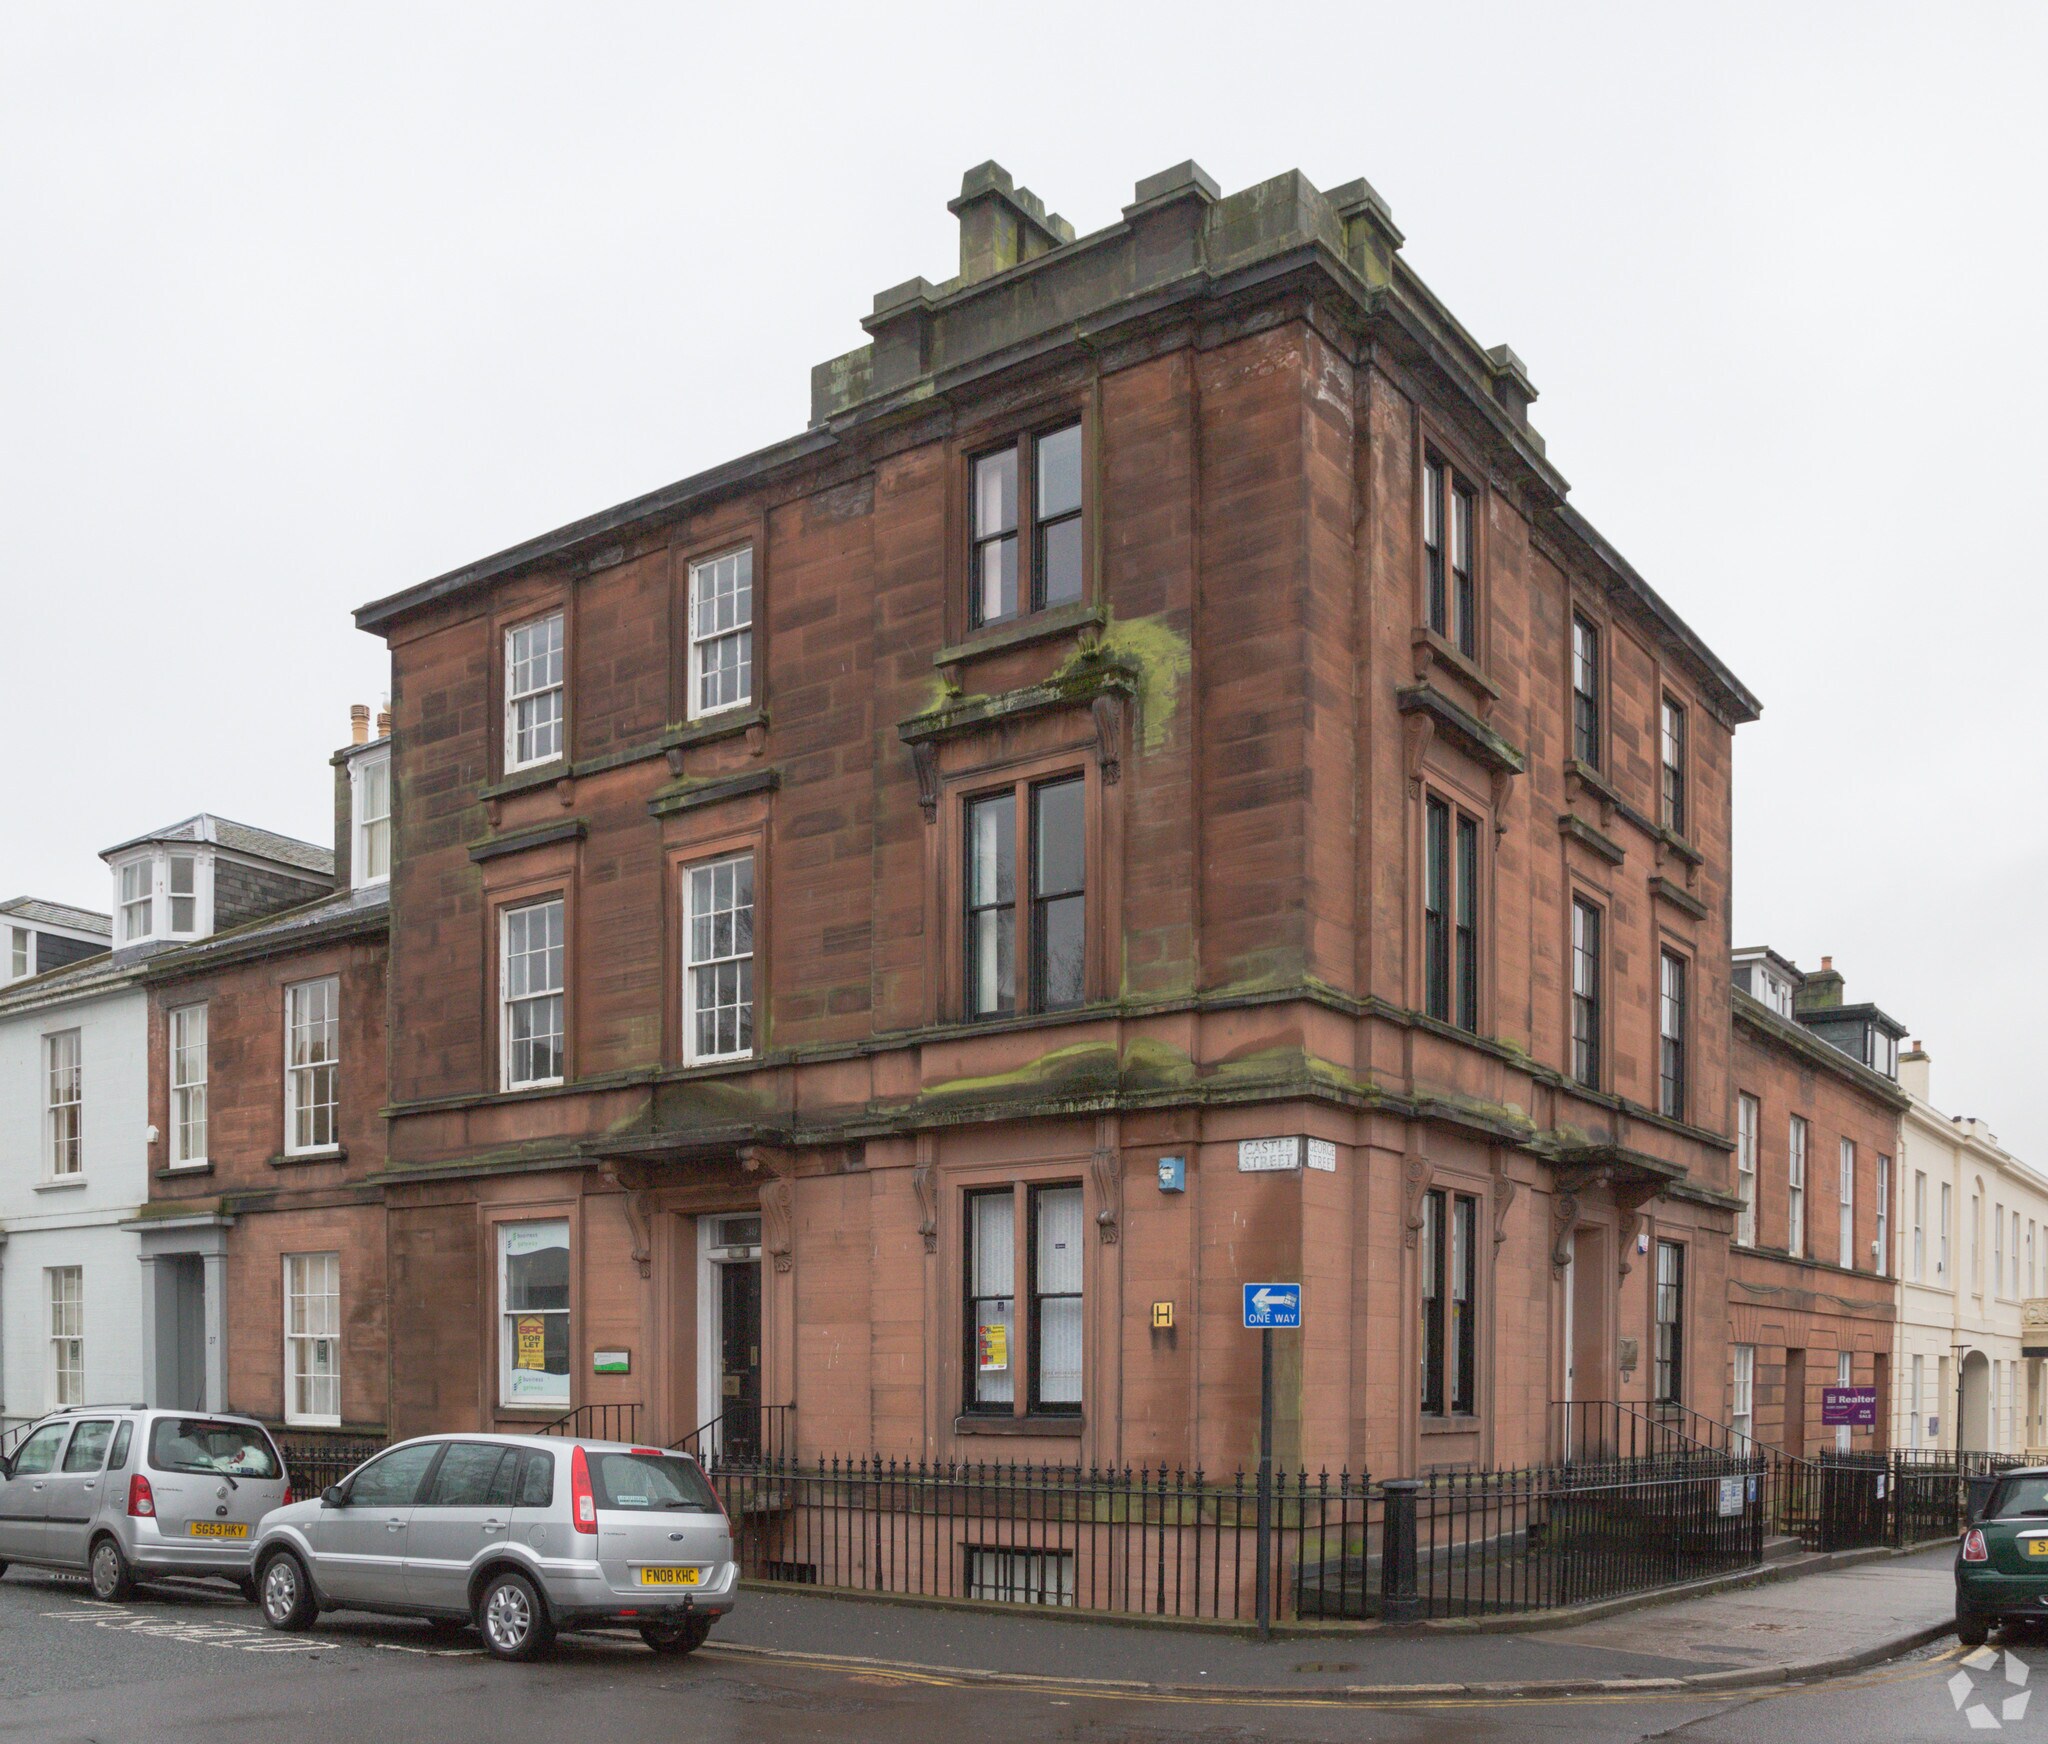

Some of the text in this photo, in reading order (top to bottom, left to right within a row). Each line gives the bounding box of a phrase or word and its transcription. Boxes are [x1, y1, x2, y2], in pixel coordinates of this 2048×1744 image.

[1243, 1139, 1293, 1155] CASTLE
[1309, 1140, 1335, 1157] GEORGE
[1244, 1154, 1293, 1169] STREET
[1308, 1154, 1335, 1170] STREET
[1156, 1304, 1170, 1324] H
[1248, 1313, 1296, 1324] ONE WAY
[519, 1325, 545, 1335] SPC
[522, 1334, 541, 1342] FOR
[195, 1523, 244, 1536] SG53 HKY
[2037, 1541, 2048, 1553] S
[646, 1569, 695, 1582] FN08 KHC
